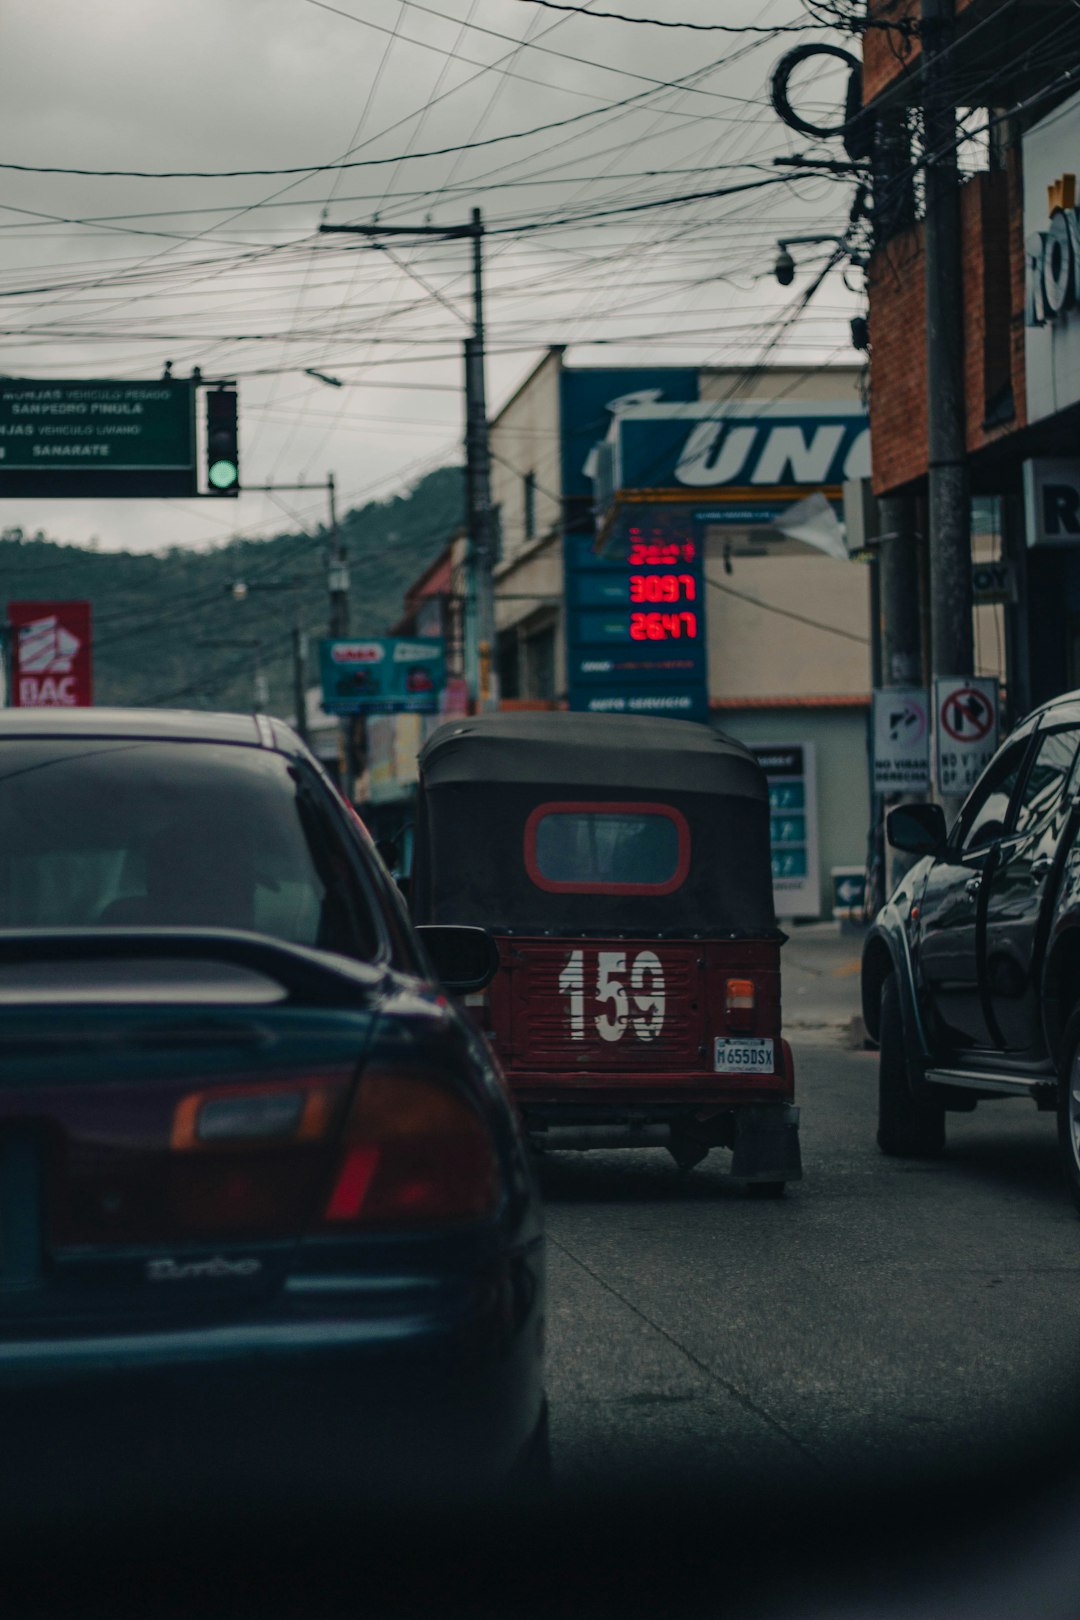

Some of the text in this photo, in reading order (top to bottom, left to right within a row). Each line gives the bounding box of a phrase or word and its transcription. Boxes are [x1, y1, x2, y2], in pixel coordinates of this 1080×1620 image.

[37, 425, 94, 436] VEHICULO
[32, 444, 112, 457] SANARATE
[20, 676, 77, 706] BAC
[558, 949, 666, 1042] 159
